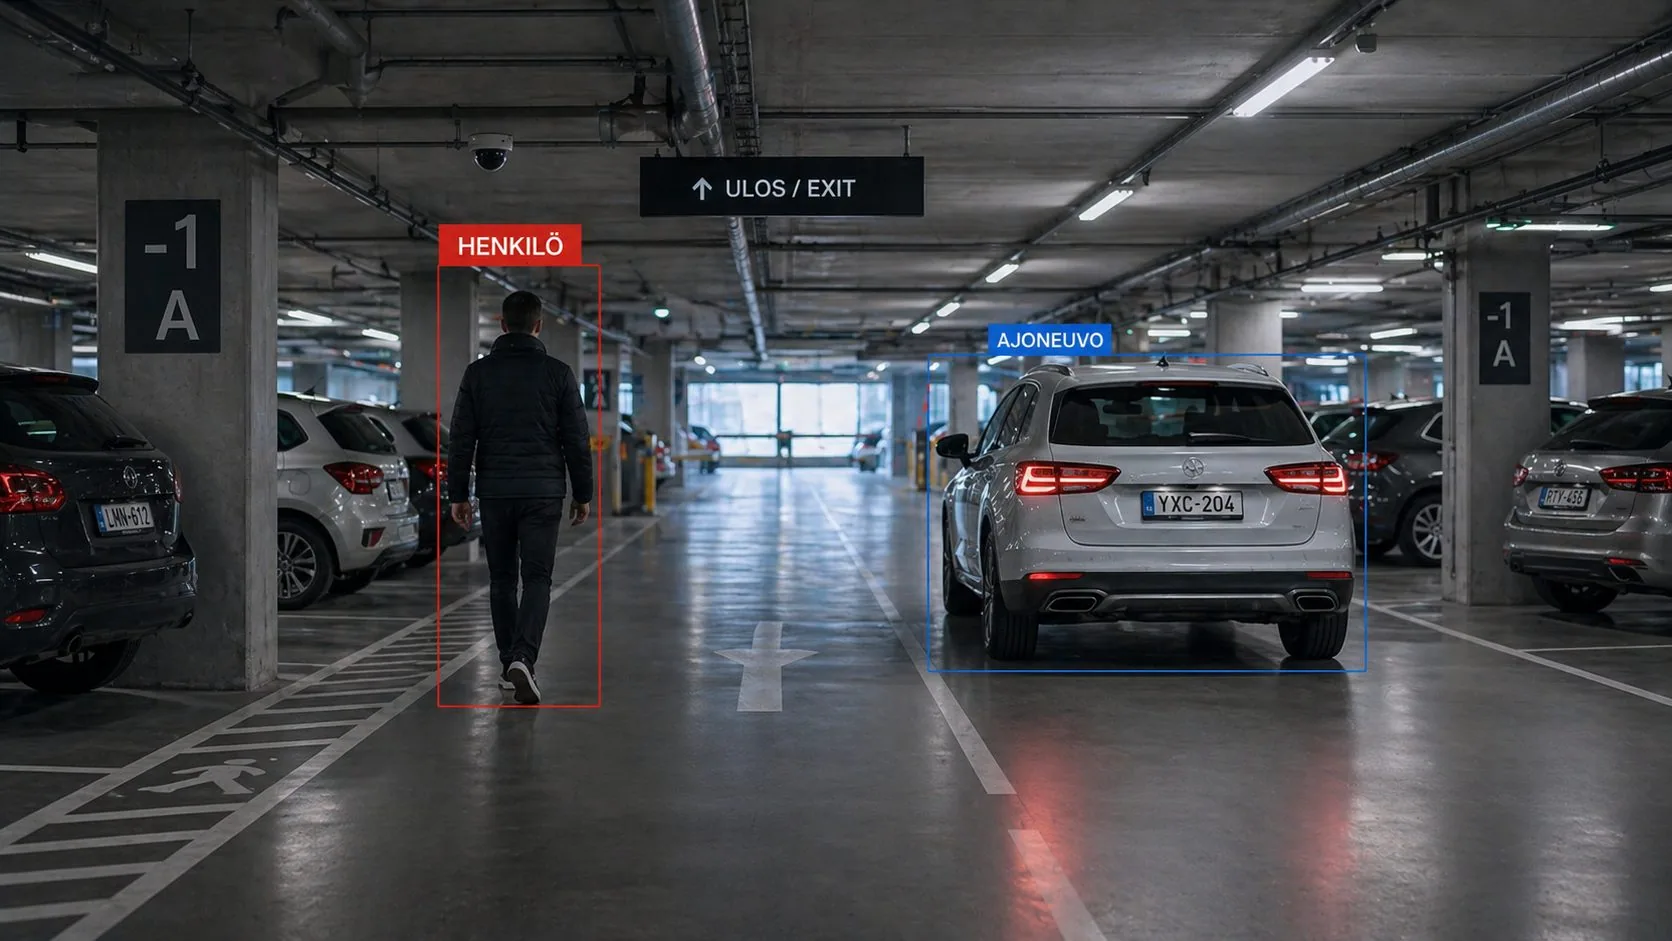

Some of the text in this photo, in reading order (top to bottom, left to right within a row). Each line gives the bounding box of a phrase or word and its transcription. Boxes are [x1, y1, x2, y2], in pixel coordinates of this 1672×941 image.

[725, 179, 857, 198] ULOS / EXIT
[144, 214, 197, 269] -1
[156, 289, 200, 341] A
[1487, 301, 1511, 329] -1
[1493, 339, 1516, 367] A
[104, 506, 150, 528] LMN-612
[1158, 495, 1235, 512] YXC-204
